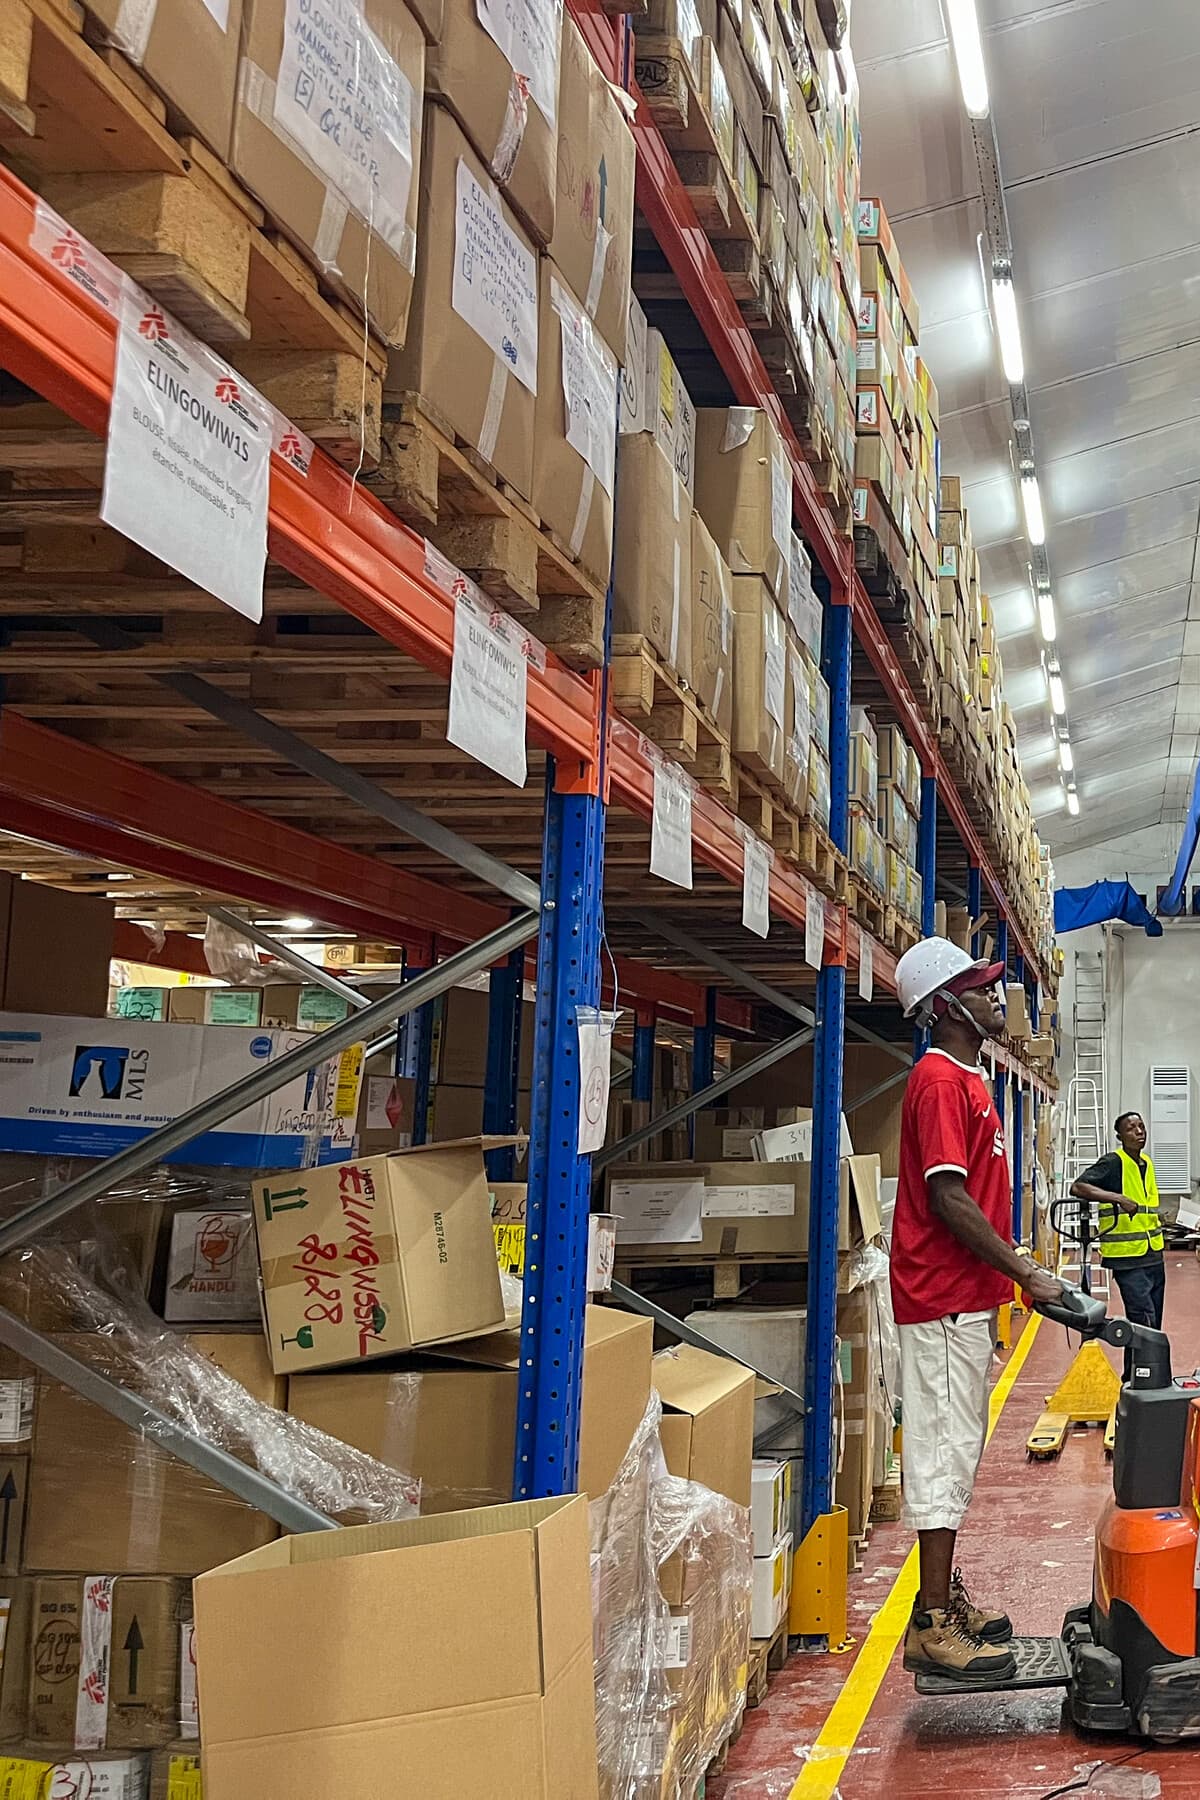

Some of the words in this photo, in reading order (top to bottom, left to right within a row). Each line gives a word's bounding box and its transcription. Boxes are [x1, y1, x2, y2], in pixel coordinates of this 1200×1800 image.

[147, 359, 250, 463] ELINGOWIW1S
[132, 405, 166, 445] BLOUSE,
[193, 456, 225, 490] manches
[125, 1049, 150, 1101] MLS
[28, 1106, 57, 1118] Driven
[59, 1107, 70, 1120] by
[72, 1110, 123, 1121] enthusiasm
[124, 1112, 142, 1122] and
[433, 1211, 448, 1265] M28746-02
